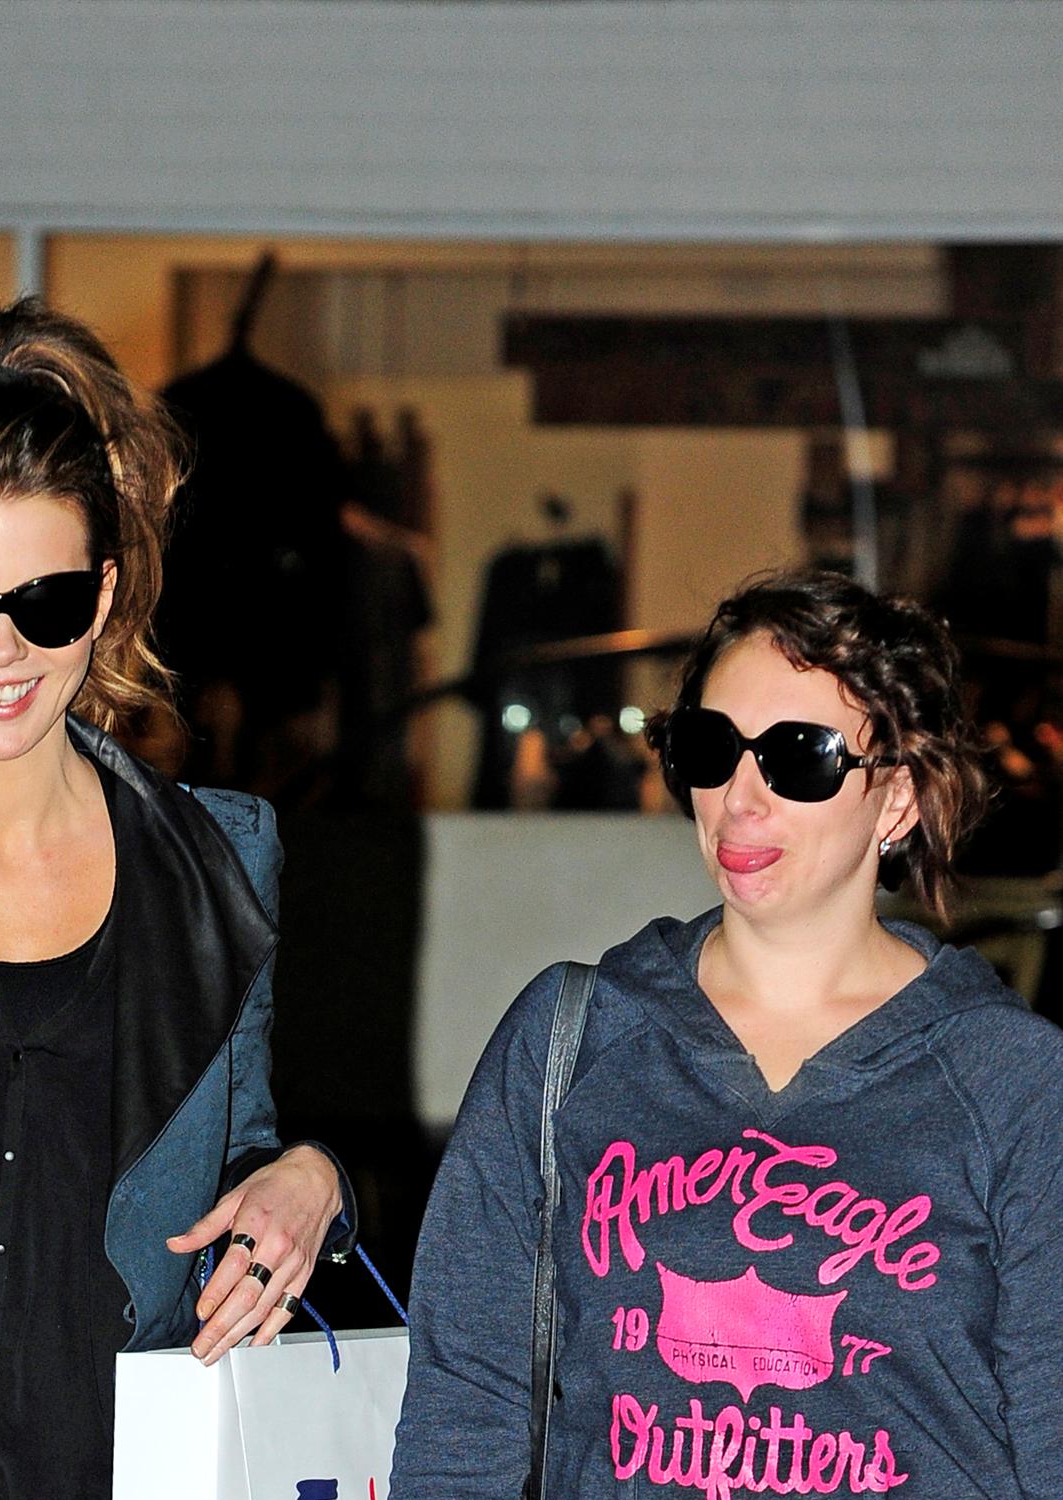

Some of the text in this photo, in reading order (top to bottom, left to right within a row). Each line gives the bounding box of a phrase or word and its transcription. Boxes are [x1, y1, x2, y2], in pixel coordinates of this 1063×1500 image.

[611, 1307, 892, 1377] 19 77
[672, 1347, 819, 1376] PHYSICAL EDUCATION
